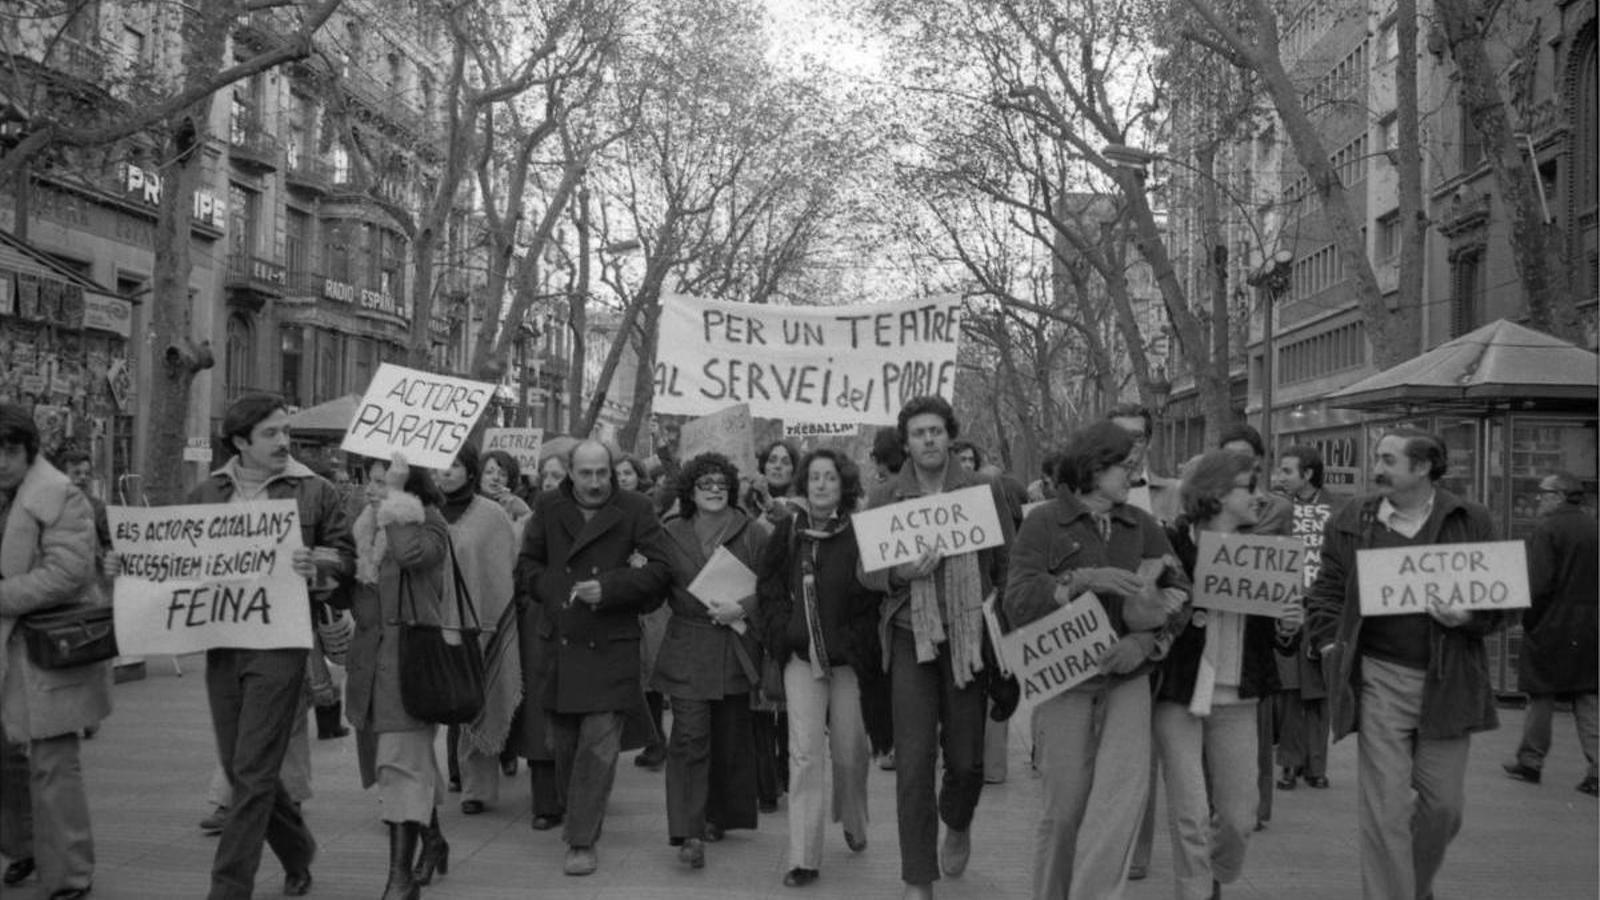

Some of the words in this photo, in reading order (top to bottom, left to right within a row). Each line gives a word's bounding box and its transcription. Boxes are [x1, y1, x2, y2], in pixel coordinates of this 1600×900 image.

[325, 279, 354, 303] RADIO
[703, 309, 766, 345] PER
[783, 319, 824, 346] UN
[836, 304, 962, 349] TEATRE
[652, 361, 683, 396] AL
[386, 378, 485, 418] ACTORS
[352, 403, 469, 454] PARATS
[489, 434, 538, 450] ACTRIZ
[145, 518, 204, 548] ACTORS
[208, 511, 296, 544] CATALANS
[890, 503, 969, 533] ACTOR
[878, 525, 986, 561] PARADO
[1212, 544, 1299, 573] ACTRIZ
[1399, 550, 1489, 575] ACTOR
[1204, 574, 1299, 603] PARADA
[1381, 580, 1509, 607] PARADO
[1022, 609, 1099, 666] ACTRIU
